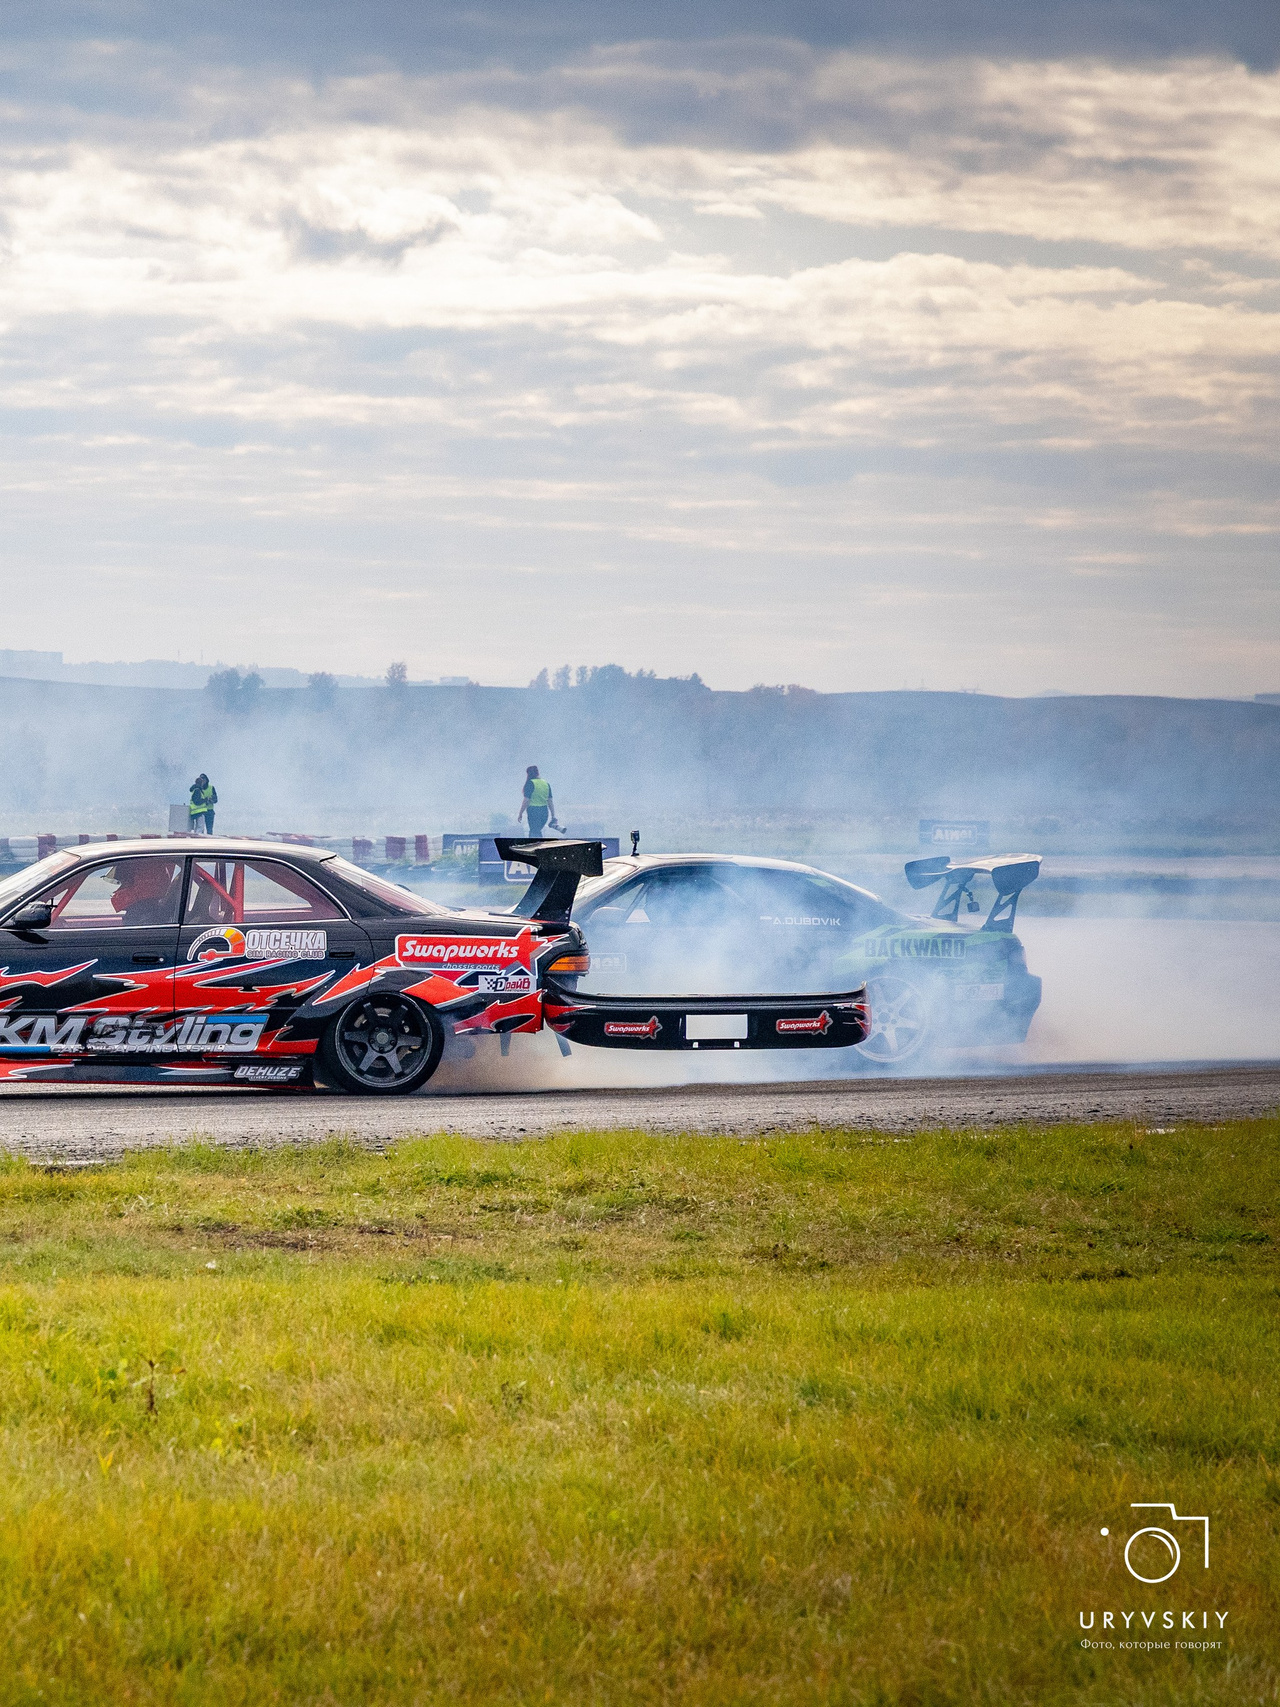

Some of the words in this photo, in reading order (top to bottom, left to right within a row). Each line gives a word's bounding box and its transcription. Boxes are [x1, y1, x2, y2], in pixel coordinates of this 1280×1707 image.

[247, 931, 326, 950] ОТСЕЧКА
[864, 937, 966, 958] BACKWARD
[266, 951, 298, 959] RACING
[402, 940, 520, 961] Swapworks
[608, 1024, 651, 1033] Swapworks
[779, 1021, 821, 1031] Swapworks
[90, 1016, 265, 1052] Styling
[237, 1066, 301, 1077] DEHUZE
